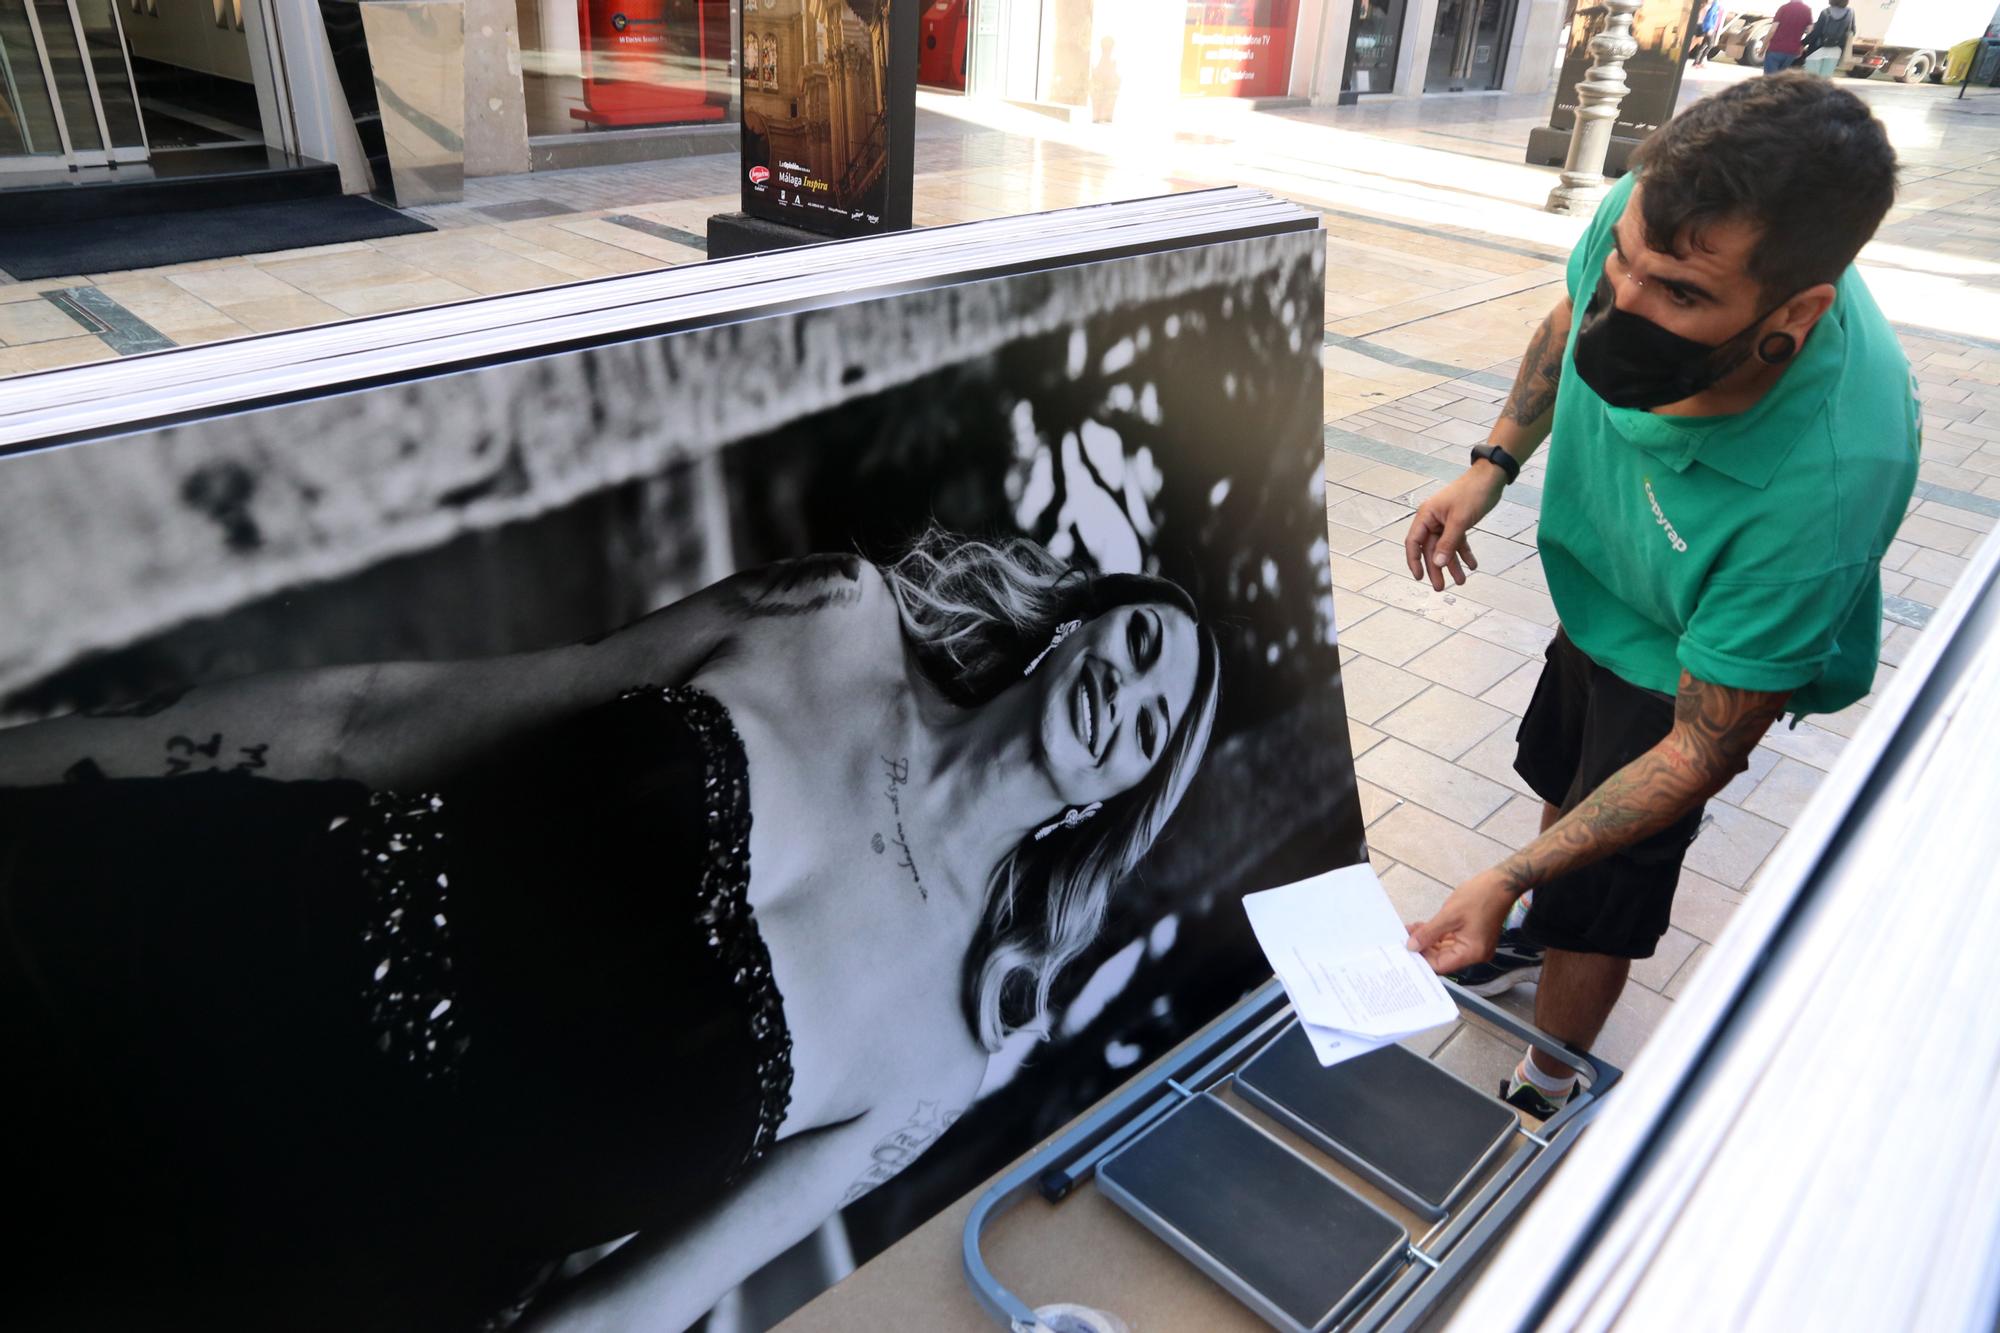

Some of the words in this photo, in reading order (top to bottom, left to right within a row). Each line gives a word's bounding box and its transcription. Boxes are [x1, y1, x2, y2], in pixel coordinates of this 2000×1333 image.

[778, 172, 802, 187] Málaga
[803, 175, 829, 192] Inspira
[1645, 482, 1687, 552] copyrap
